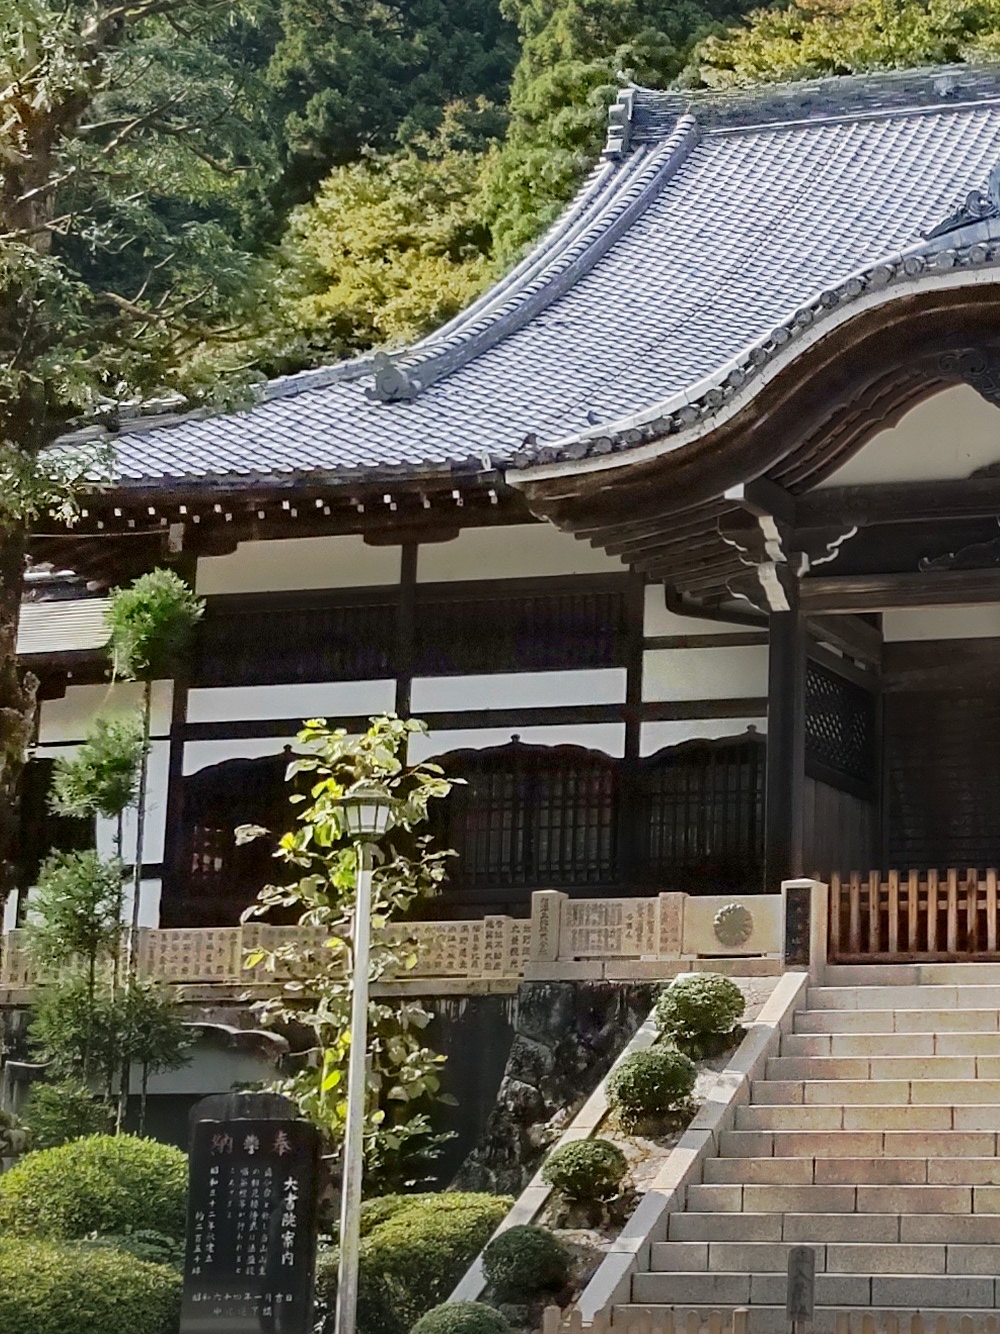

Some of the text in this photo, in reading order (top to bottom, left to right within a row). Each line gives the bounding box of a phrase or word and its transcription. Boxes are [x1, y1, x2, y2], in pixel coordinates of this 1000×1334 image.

[281, 1176, 299, 1266] 大書院案内
